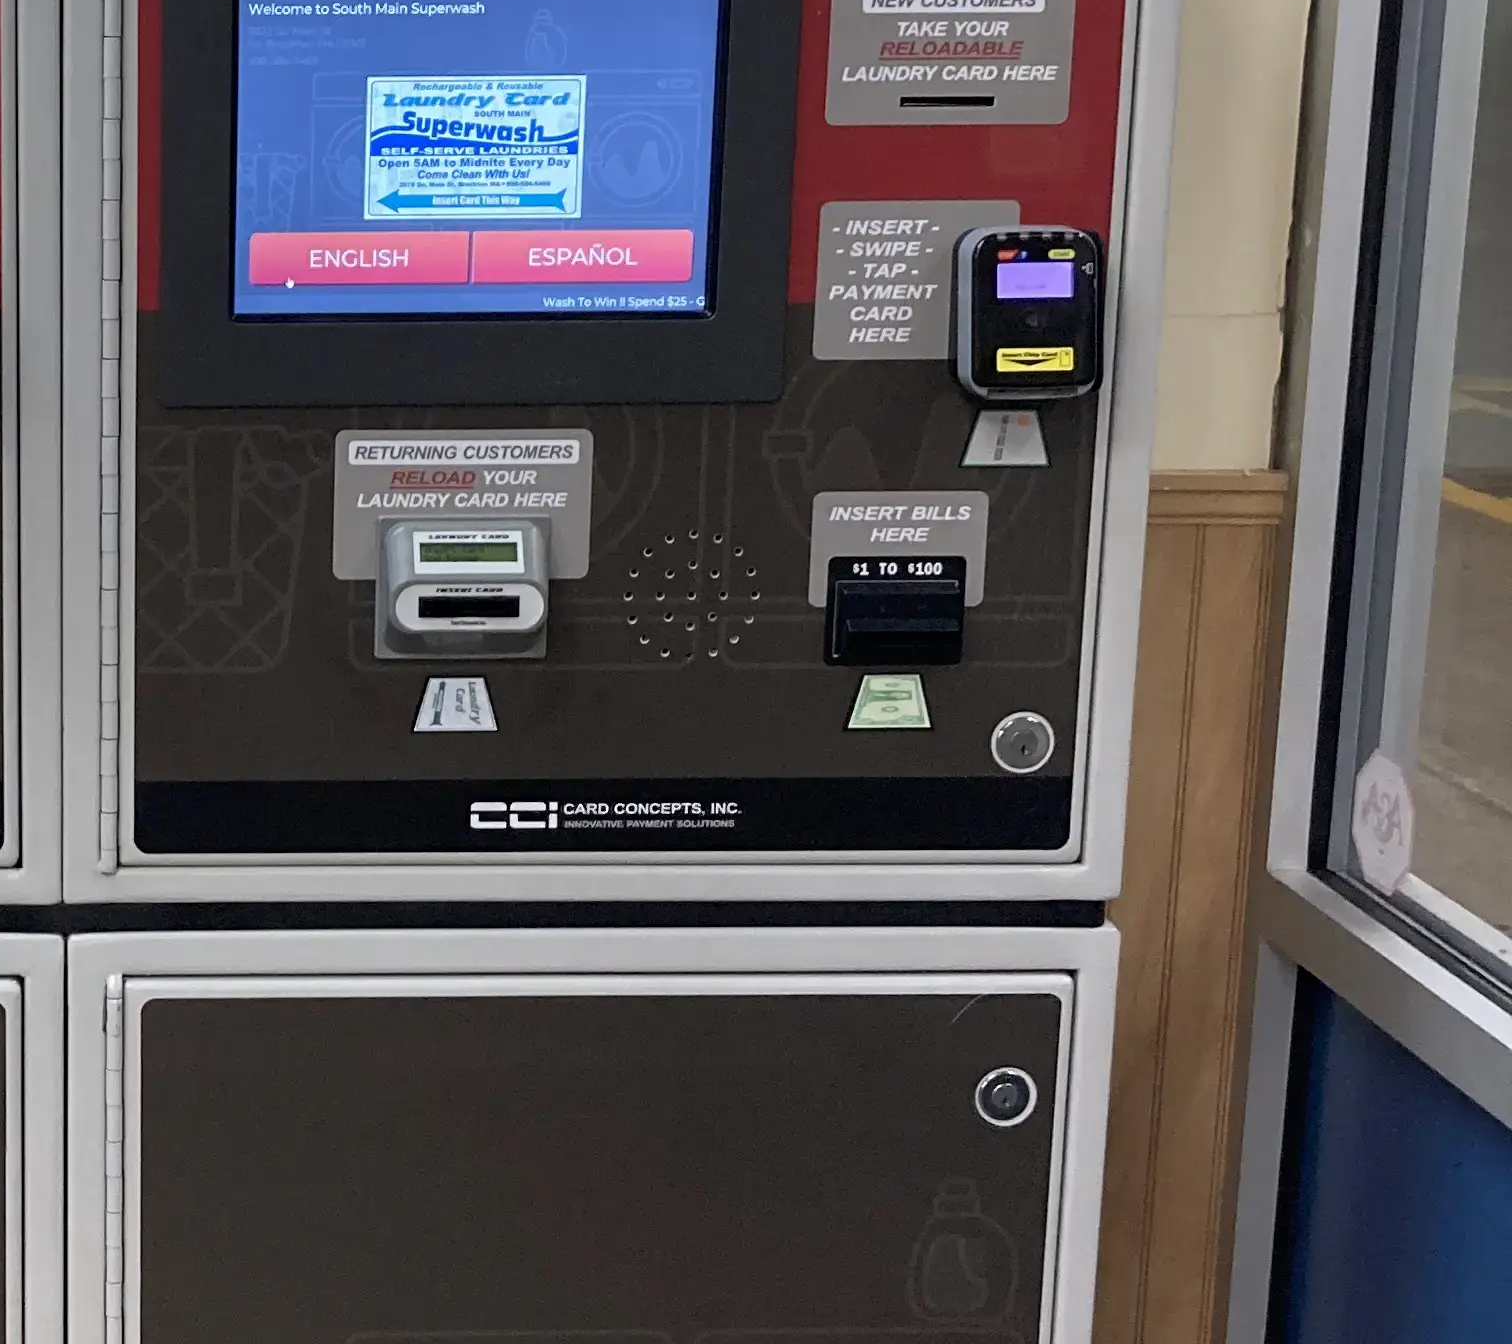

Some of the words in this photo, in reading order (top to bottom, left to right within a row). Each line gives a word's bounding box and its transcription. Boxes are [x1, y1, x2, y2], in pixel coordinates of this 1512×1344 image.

[248, 3, 312, 16] Welcome
[315, 3, 329, 16] to
[332, 2, 372, 15] South
[375, 2, 408, 15] Main
[411, 2, 485, 17] Superwash
[897, 21, 948, 37] TAKE
[954, 21, 1009, 37] YOUR
[879, 41, 1024, 57] RELOADABLE
[841, 66, 938, 82] LAUNDRY
[942, 66, 998, 81] CARD
[1002, 66, 1059, 81] HERE
[413, 82, 482, 92] Rechargeable
[496, 82, 543, 90] Reusable
[383, 93, 495, 108] Laundry
[504, 92, 571, 106] Card
[402, 110, 545, 143] Superwash
[381, 147, 475, 155] SELF-SERVE
[479, 146, 569, 155] LAUNDRIES
[378, 159, 409, 169] Open
[413, 158, 440, 167] 5AM
[444, 159, 456, 167] to
[460, 158, 505, 167] Midnite
[509, 158, 543, 169] Every
[547, 158, 570, 168] Day
[417, 170, 448, 179] Come
[452, 170, 481, 179] Clean
[485, 170, 509, 178] With
[512, 170, 530, 178] Us!
[432, 196, 458, 205] Insert
[459, 196, 480, 205] Card
[482, 196, 500, 205] This
[500, 196, 520, 206] Way
[846, 220, 928, 235] INSERT
[309, 249, 409, 268] ENGLISH
[528, 244, 637, 267] ESPAÑOL
[849, 242, 921, 257] SWIPE
[863, 263, 907, 279] TAP
[829, 284, 938, 300] PAYMENT
[543, 297, 575, 307] Wash
[578, 297, 592, 307] To
[594, 297, 617, 307] Win
[627, 296, 665, 309] Spend
[667, 295, 687, 307] $25
[850, 306, 913, 321] CARD
[849, 328, 911, 343] HERE
[354, 445, 458, 460] RETURNING
[463, 444, 573, 459] CUSTOMERS
[391, 470, 476, 485] RELOAD
[483, 470, 538, 485] YOUR
[357, 493, 451, 508] LAUNDRY
[453, 492, 509, 508] CARD
[514, 492, 568, 507] HERE
[829, 506, 908, 521] INSERT
[911, 506, 972, 521] BILLS
[870, 527, 930, 542] HERE
[852, 563, 869, 576] $1
[879, 563, 898, 575] TO
[908, 562, 943, 575] $100
[455, 688, 466, 712] Card
[563, 803, 609, 815] CARD
[613, 802, 706, 816] CONCEPTS,
[710, 802, 742, 814] INC.
[564, 820, 624, 829] INNOVATIVE
[626, 820, 674, 828] PAYMENT
[676, 819, 735, 828] SOLUTIONS
